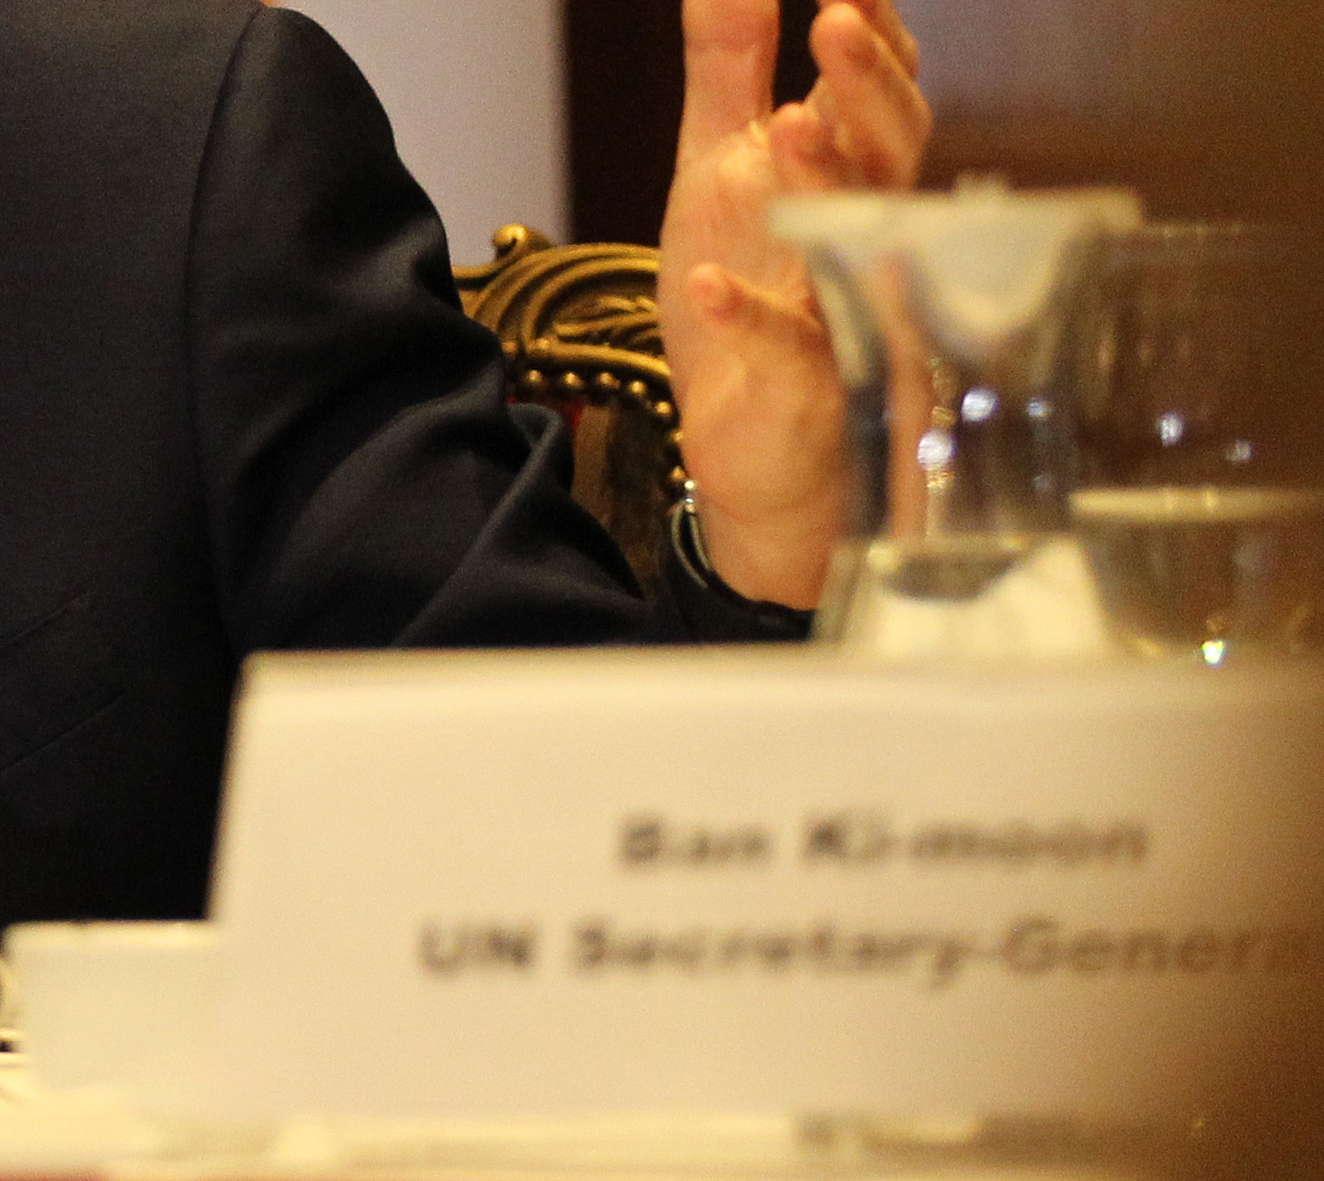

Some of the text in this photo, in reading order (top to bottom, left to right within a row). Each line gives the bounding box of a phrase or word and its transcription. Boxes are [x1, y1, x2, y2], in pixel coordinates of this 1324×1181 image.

[618, 812, 1152, 871] Ban Ki-moon
[418, 914, 1312, 986] UN Secretary-Genera
